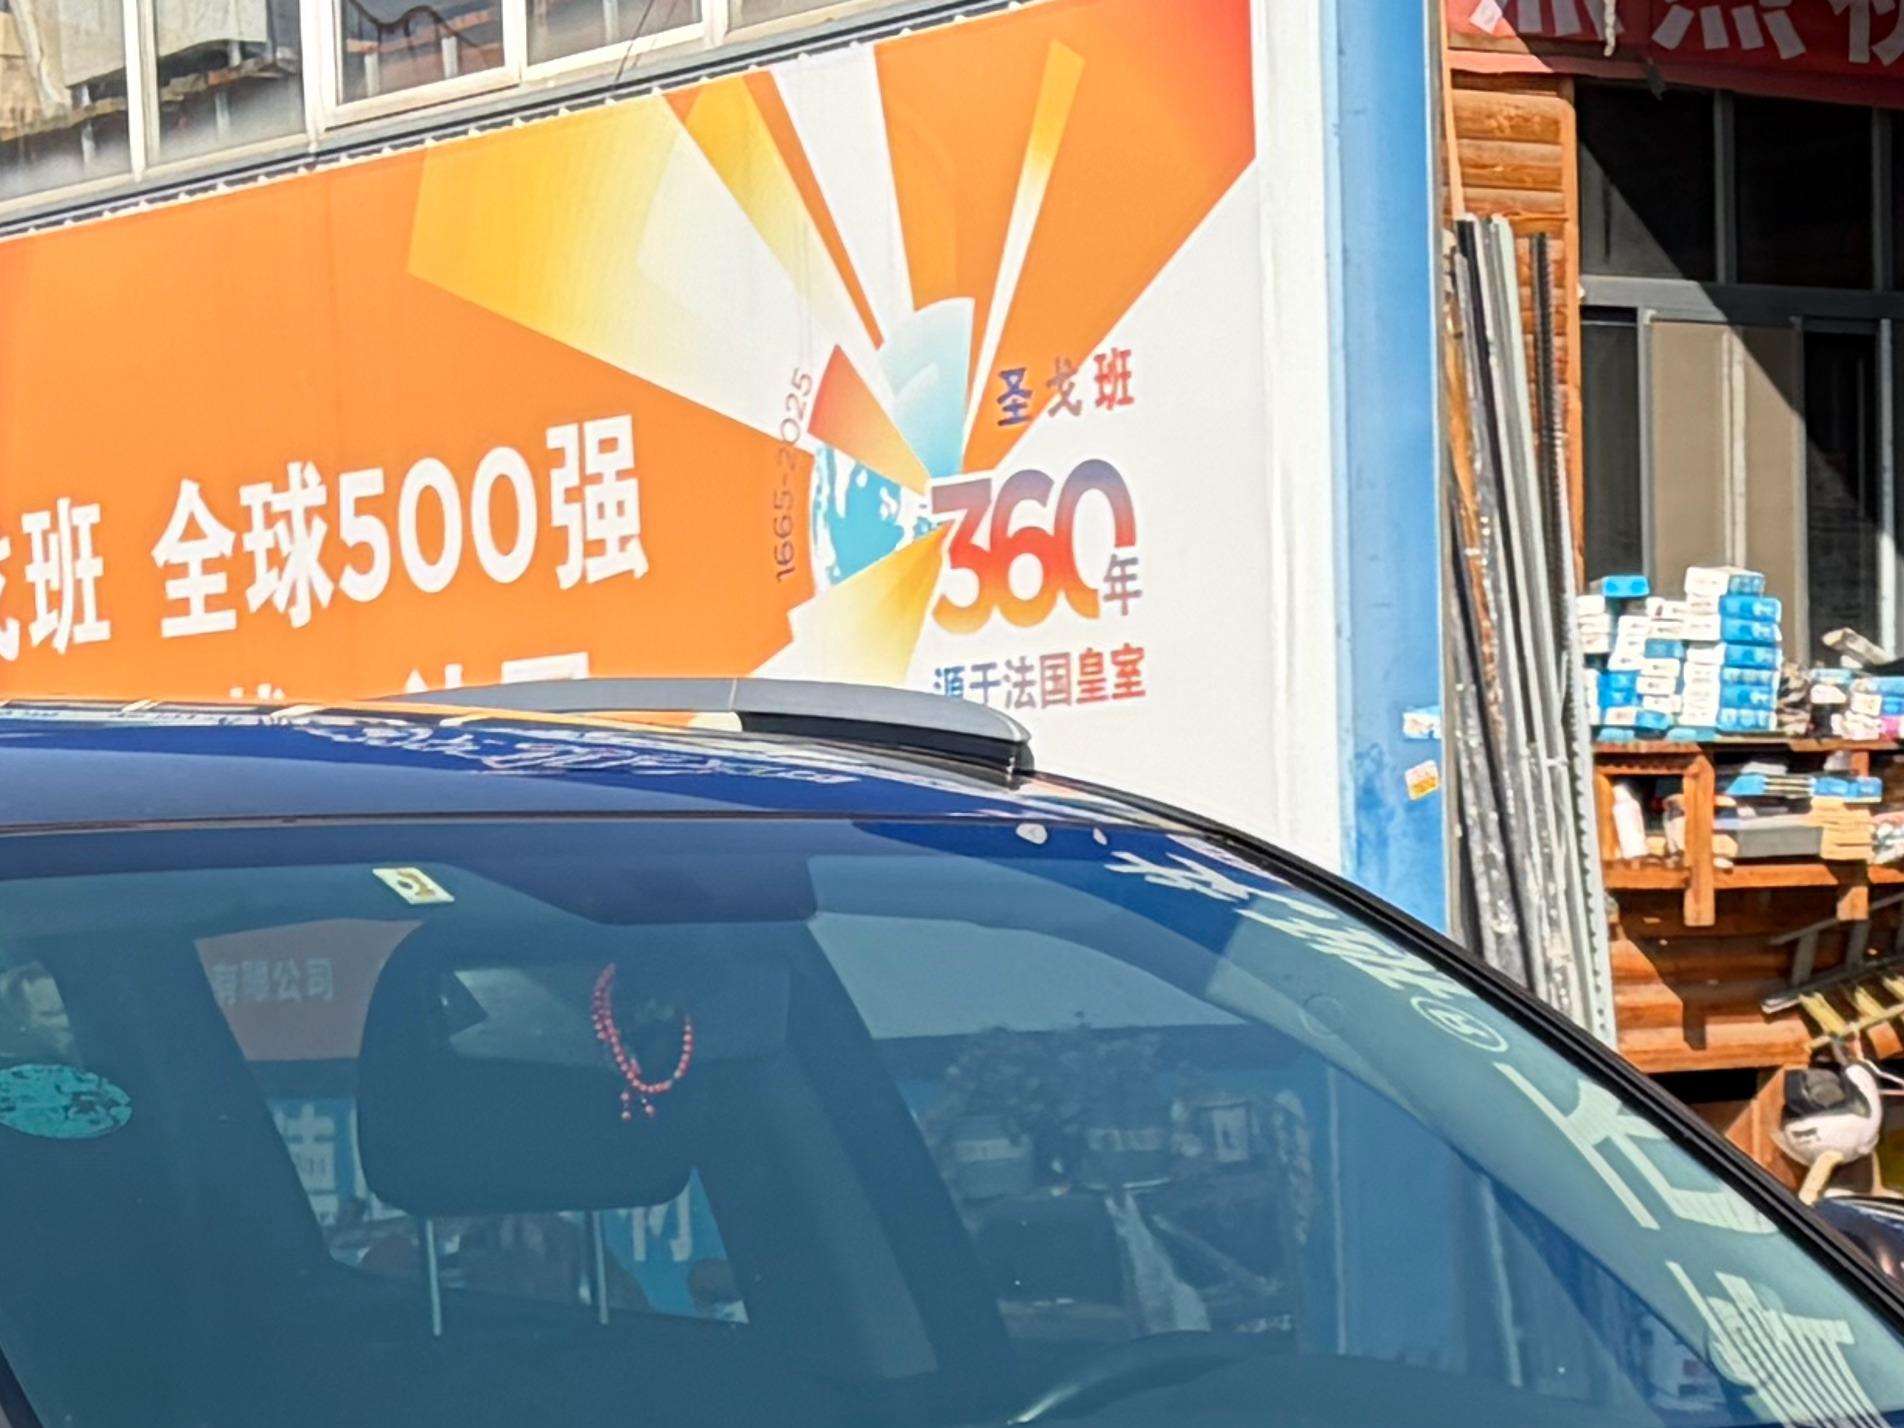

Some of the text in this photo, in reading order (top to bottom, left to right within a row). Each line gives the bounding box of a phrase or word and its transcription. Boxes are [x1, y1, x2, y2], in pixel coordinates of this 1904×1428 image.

[996, 348, 1135, 427] 圣戈班
[151, 413, 651, 638] 全球500强
[774, 367, 814, 582] 1665-2025
[933, 642, 1147, 711] 源于法国皇室
